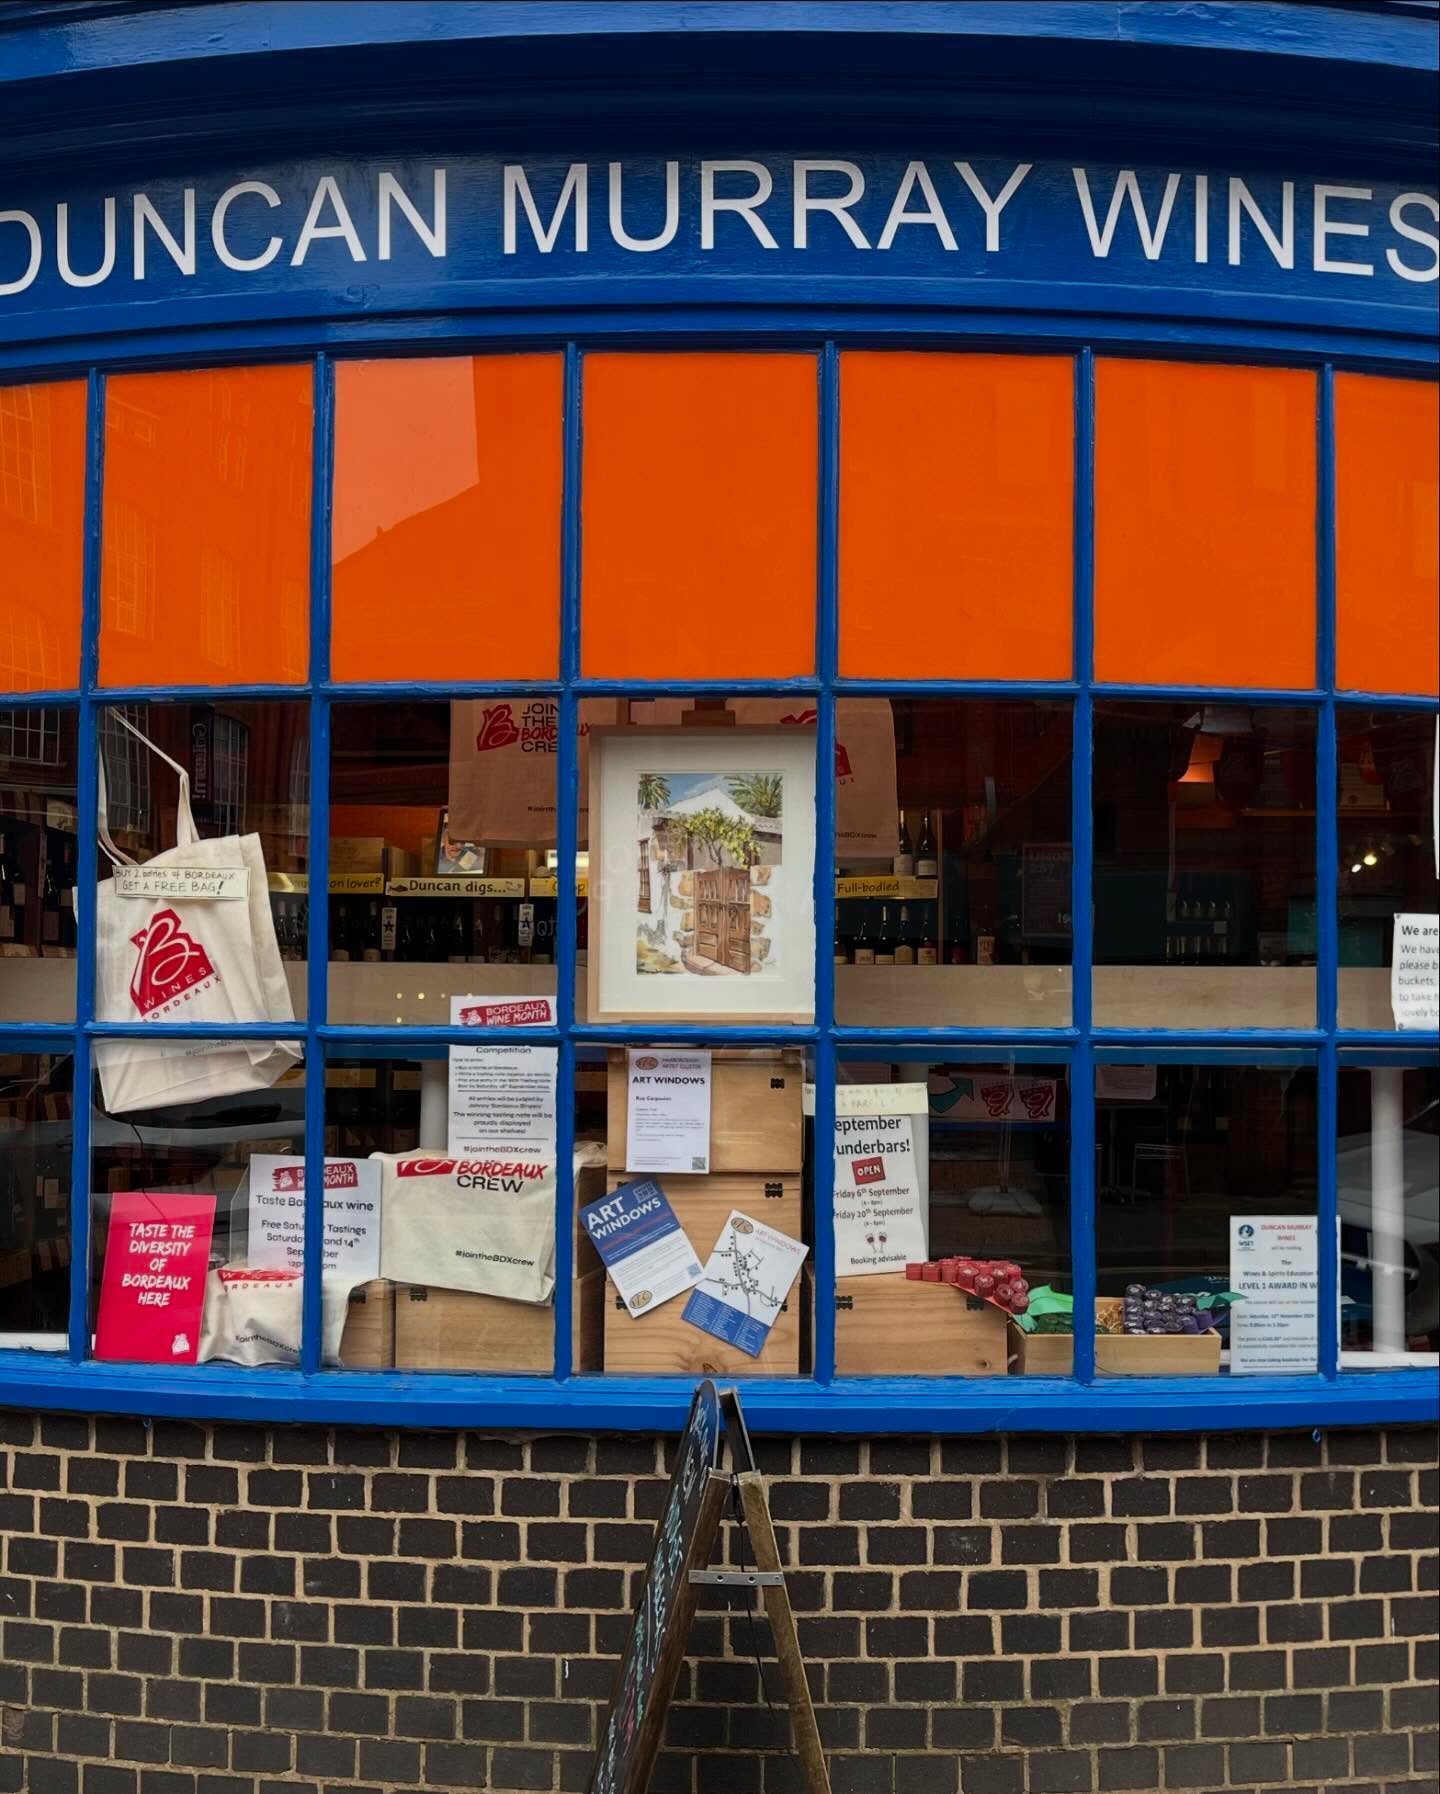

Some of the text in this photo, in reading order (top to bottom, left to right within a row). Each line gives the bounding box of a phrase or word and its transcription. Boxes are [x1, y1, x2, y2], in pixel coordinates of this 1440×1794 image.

[0, 159, 1440, 296] DUNCAN MURRAY WINES
[521, 716, 558, 728] THE
[521, 742, 559, 753] CRE
[134, 870, 139, 878] 2
[184, 870, 236, 880] BORDEAUX
[122, 880, 225, 895] GET A FREE BAG!
[347, 877, 382, 889] lover?
[409, 879, 461, 892] Duncan
[837, 880, 900, 894] Full-bodied
[1402, 925, 1439, 936] We are
[1401, 944, 1417, 954] We
[1400, 960, 1428, 970] please
[144, 967, 207, 1009] WINES
[1400, 993, 1408, 1001] to
[1411, 992, 1432, 1001] take
[486, 1001, 547, 1016] BORDEAUX
[486, 1009, 547, 1026] WINE MONTH
[476, 1046, 532, 1054] Competition
[632, 1076, 705, 1085] ART WINDOWS
[835, 1114, 902, 1135] eptember
[464, 1145, 542, 1154] #jointheBDXcrew
[836, 1138, 911, 1155] underbars!
[457, 1160, 549, 1181] BORDEAUX
[857, 1165, 881, 1177] OPEN
[457, 1175, 524, 1193] CREW
[868, 1186, 910, 1198] September
[256, 1194, 286, 1207] Taste
[346, 1200, 374, 1212] wine
[588, 1196, 625, 1230] ART
[592, 1197, 661, 1240] WINDOWS
[873, 1207, 914, 1218] September
[129, 1223, 195, 1239] TASTE THE
[262, 1219, 282, 1229] Free
[327, 1223, 367, 1237] Tastings
[266, 1232, 305, 1243] Saturda
[129, 1240, 192, 1257] DIVERSITY
[455, 1249, 535, 1267] #jointheBDXcrew
[851, 1253, 907, 1265] Booking advisable
[149, 1258, 168, 1273] OF
[121, 1273, 191, 1291] BORDEAUX
[1239, 1282, 1260, 1290] LEVEL
[137, 1292, 171, 1308] HERE
